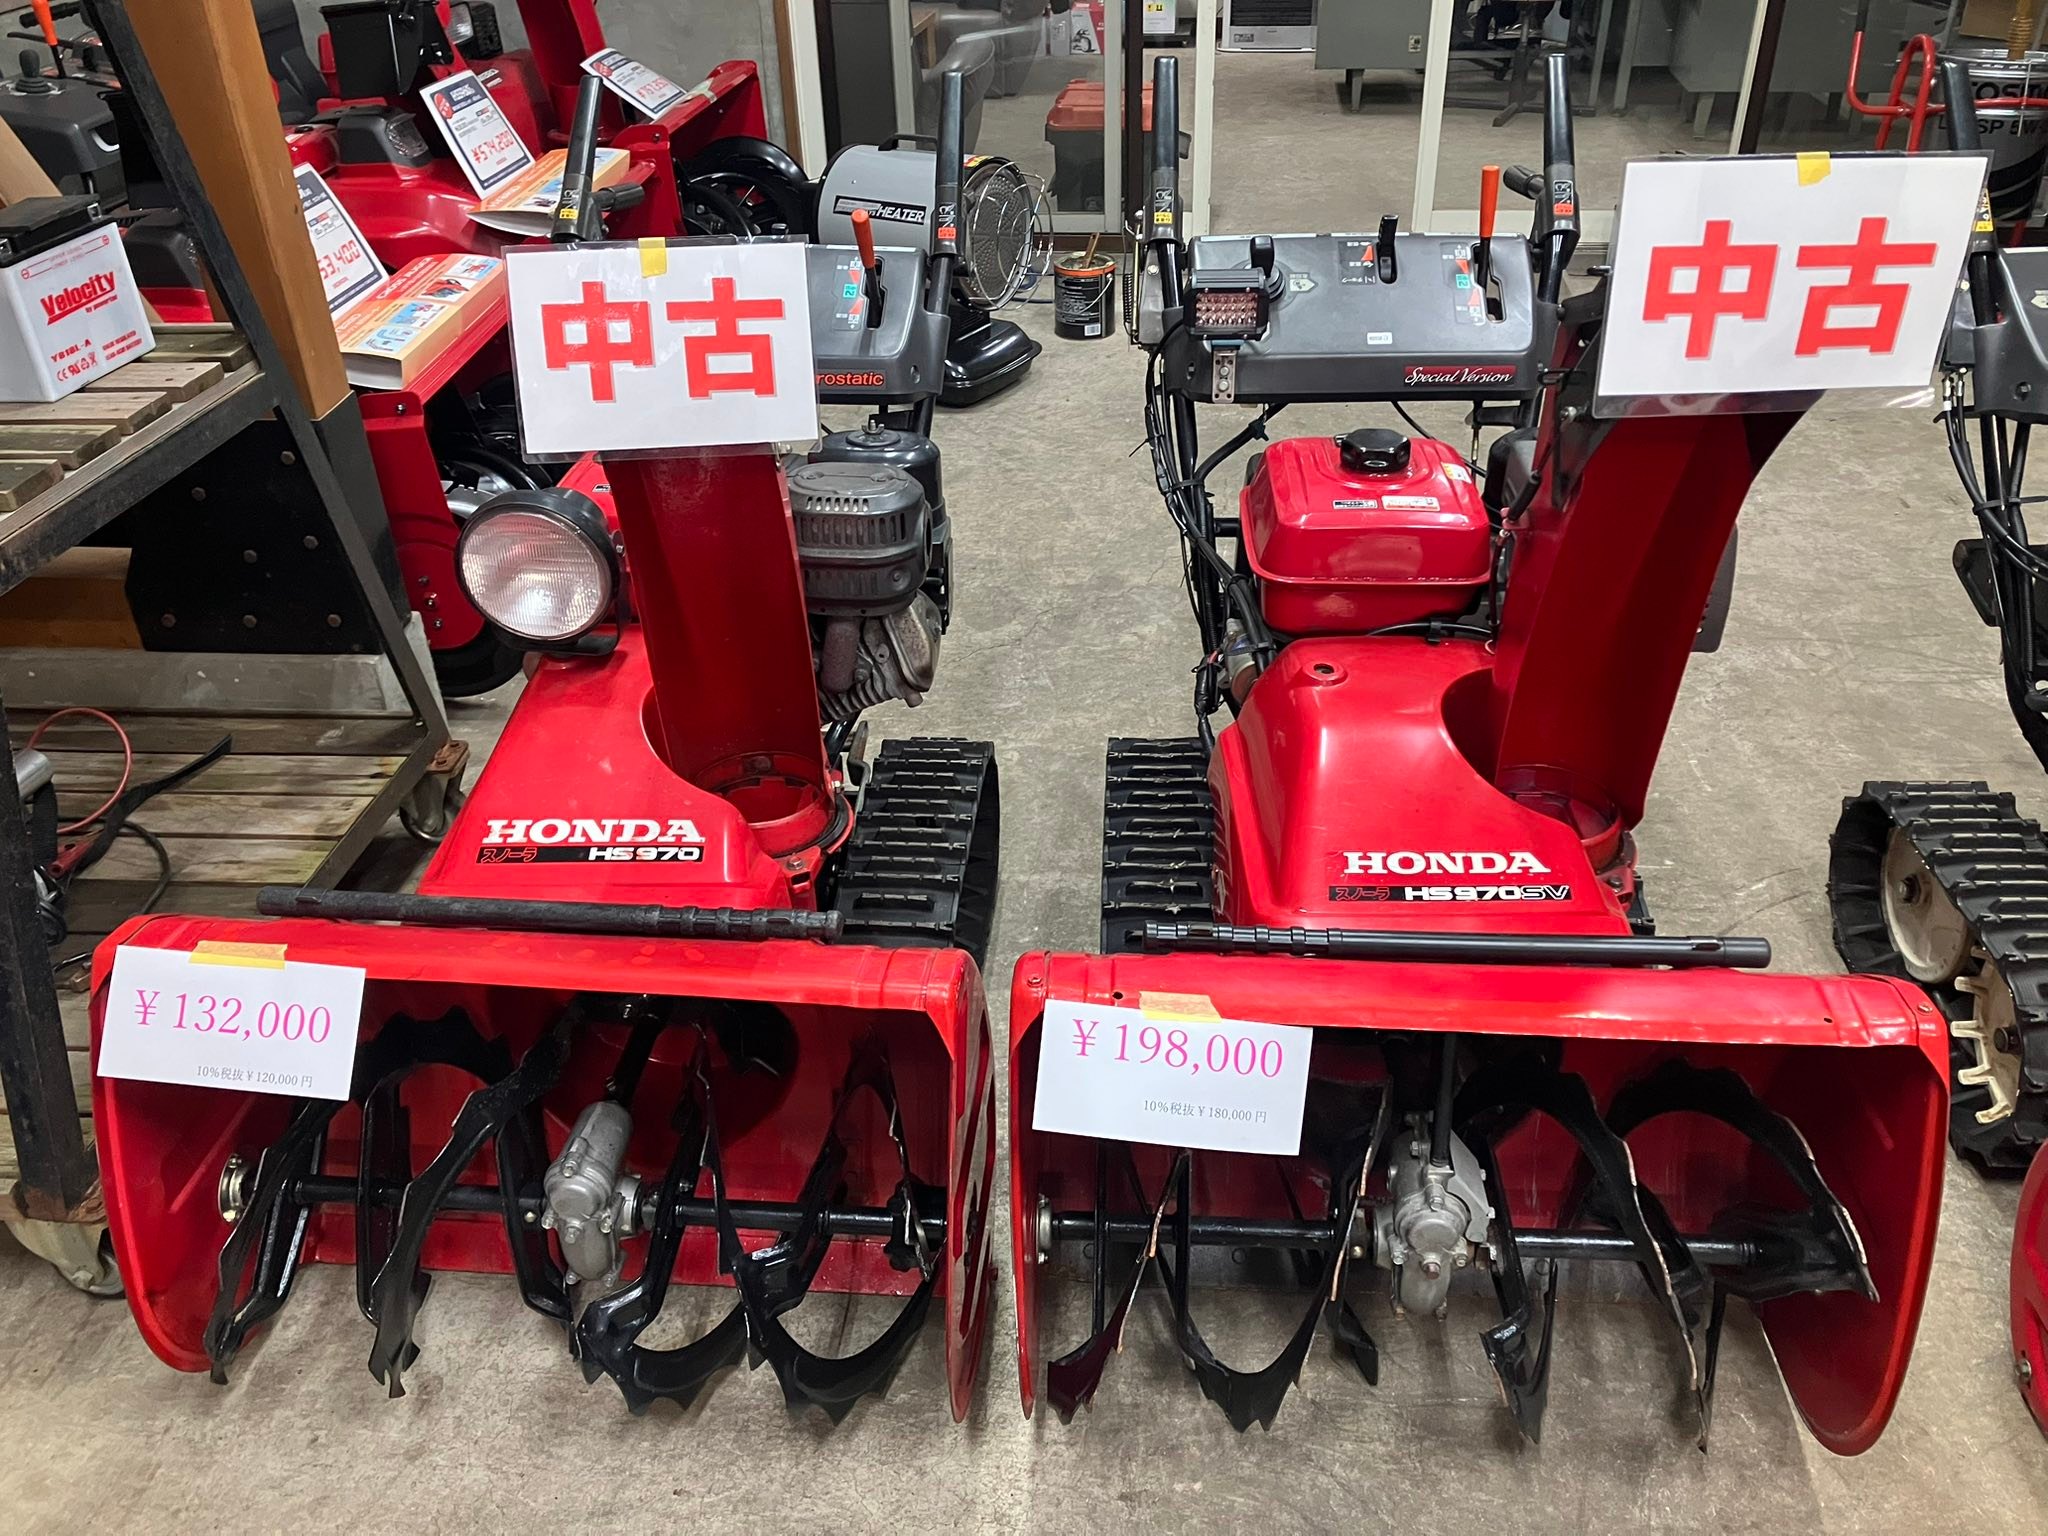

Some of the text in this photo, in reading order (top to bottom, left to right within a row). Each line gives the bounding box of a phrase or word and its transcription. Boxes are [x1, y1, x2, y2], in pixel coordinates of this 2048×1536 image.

[876, 206, 925, 222] HEATER
[40, 271, 116, 317] Velocity
[1643, 217, 1938, 360] 中古
[541, 277, 785, 403] 中古
[1404, 367, 1513, 386] Special Version
[482, 819, 706, 844] HONDA
[480, 847, 701, 862] スノーラ HS970
[1343, 851, 1552, 875] HONDA
[1404, 885, 1570, 901] HS970SV
